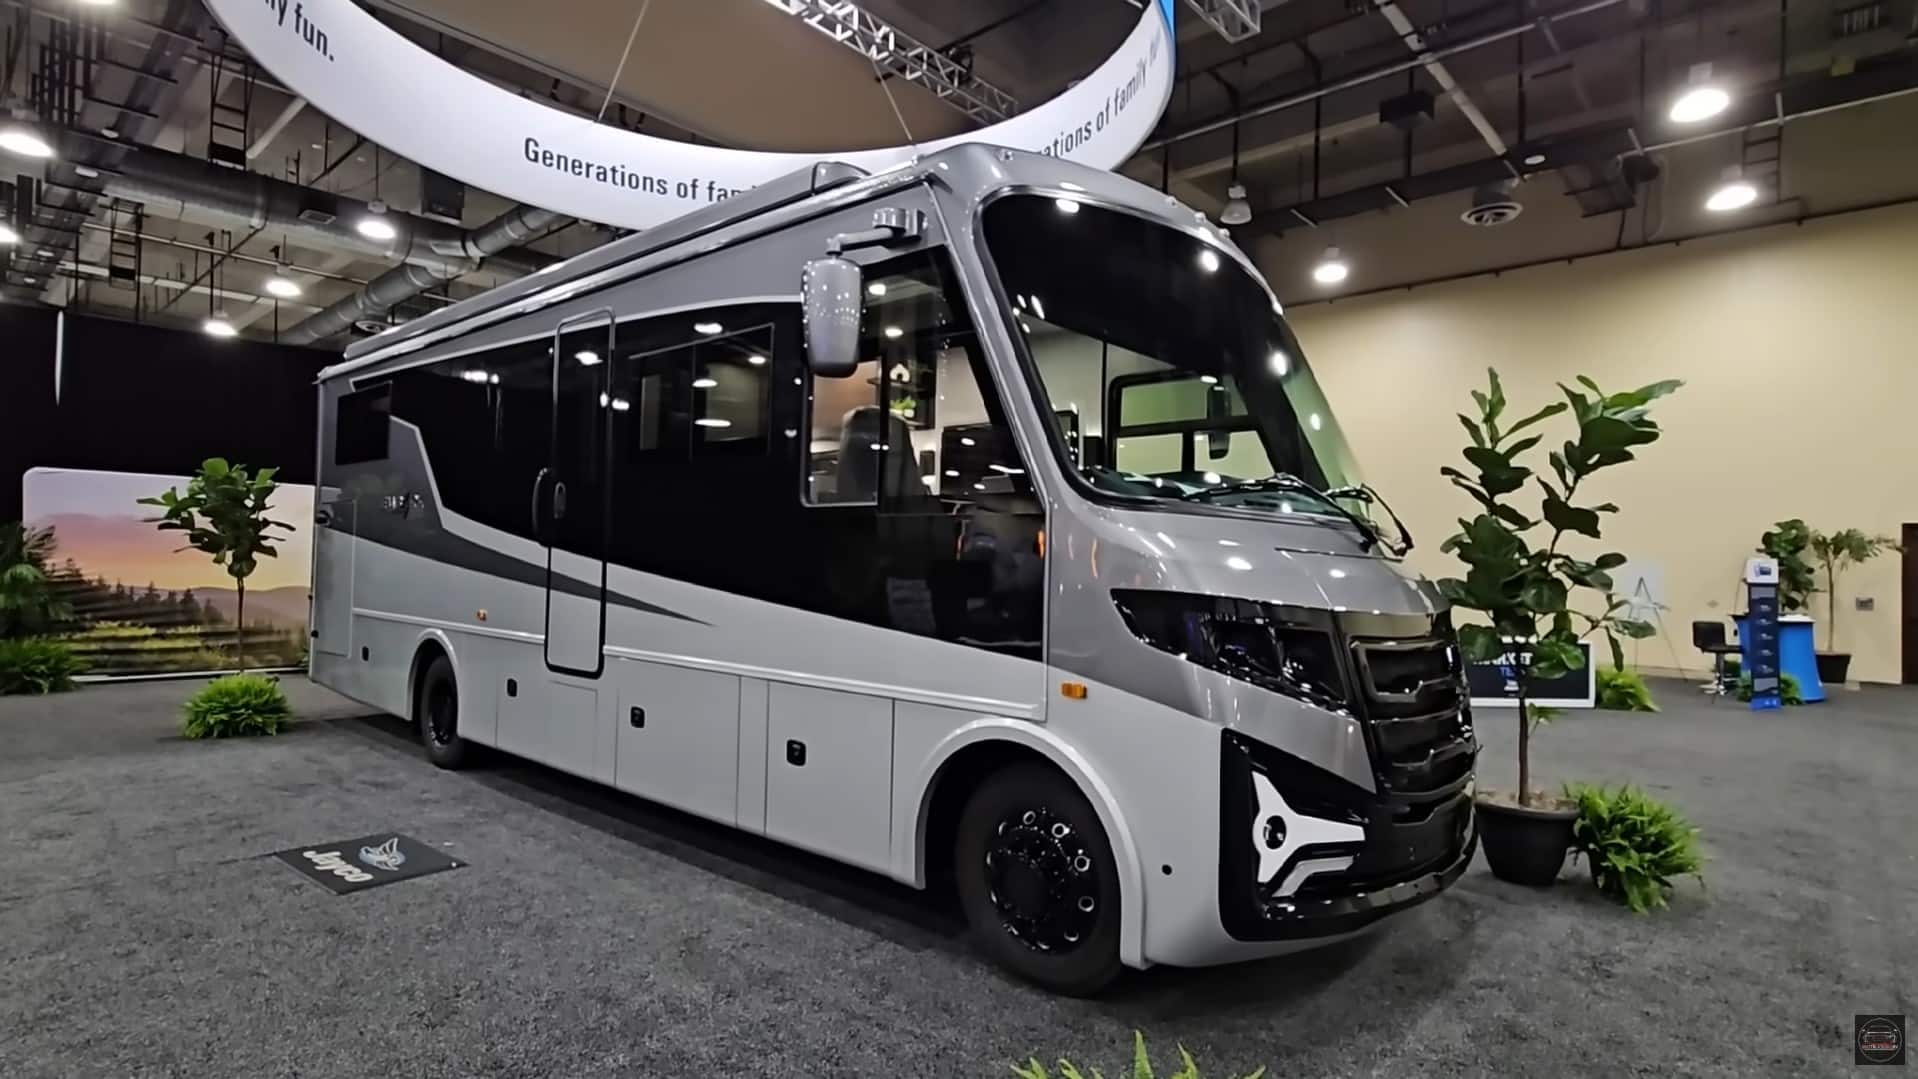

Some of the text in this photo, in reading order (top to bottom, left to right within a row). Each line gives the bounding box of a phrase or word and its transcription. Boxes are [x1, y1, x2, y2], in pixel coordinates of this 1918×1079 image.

[294, 2, 335, 62] fun.
[1041, 120, 1092, 159] ations
[1096, 97, 1111, 132] of
[524, 137, 668, 195] Generations
[676, 178, 700, 200] of
